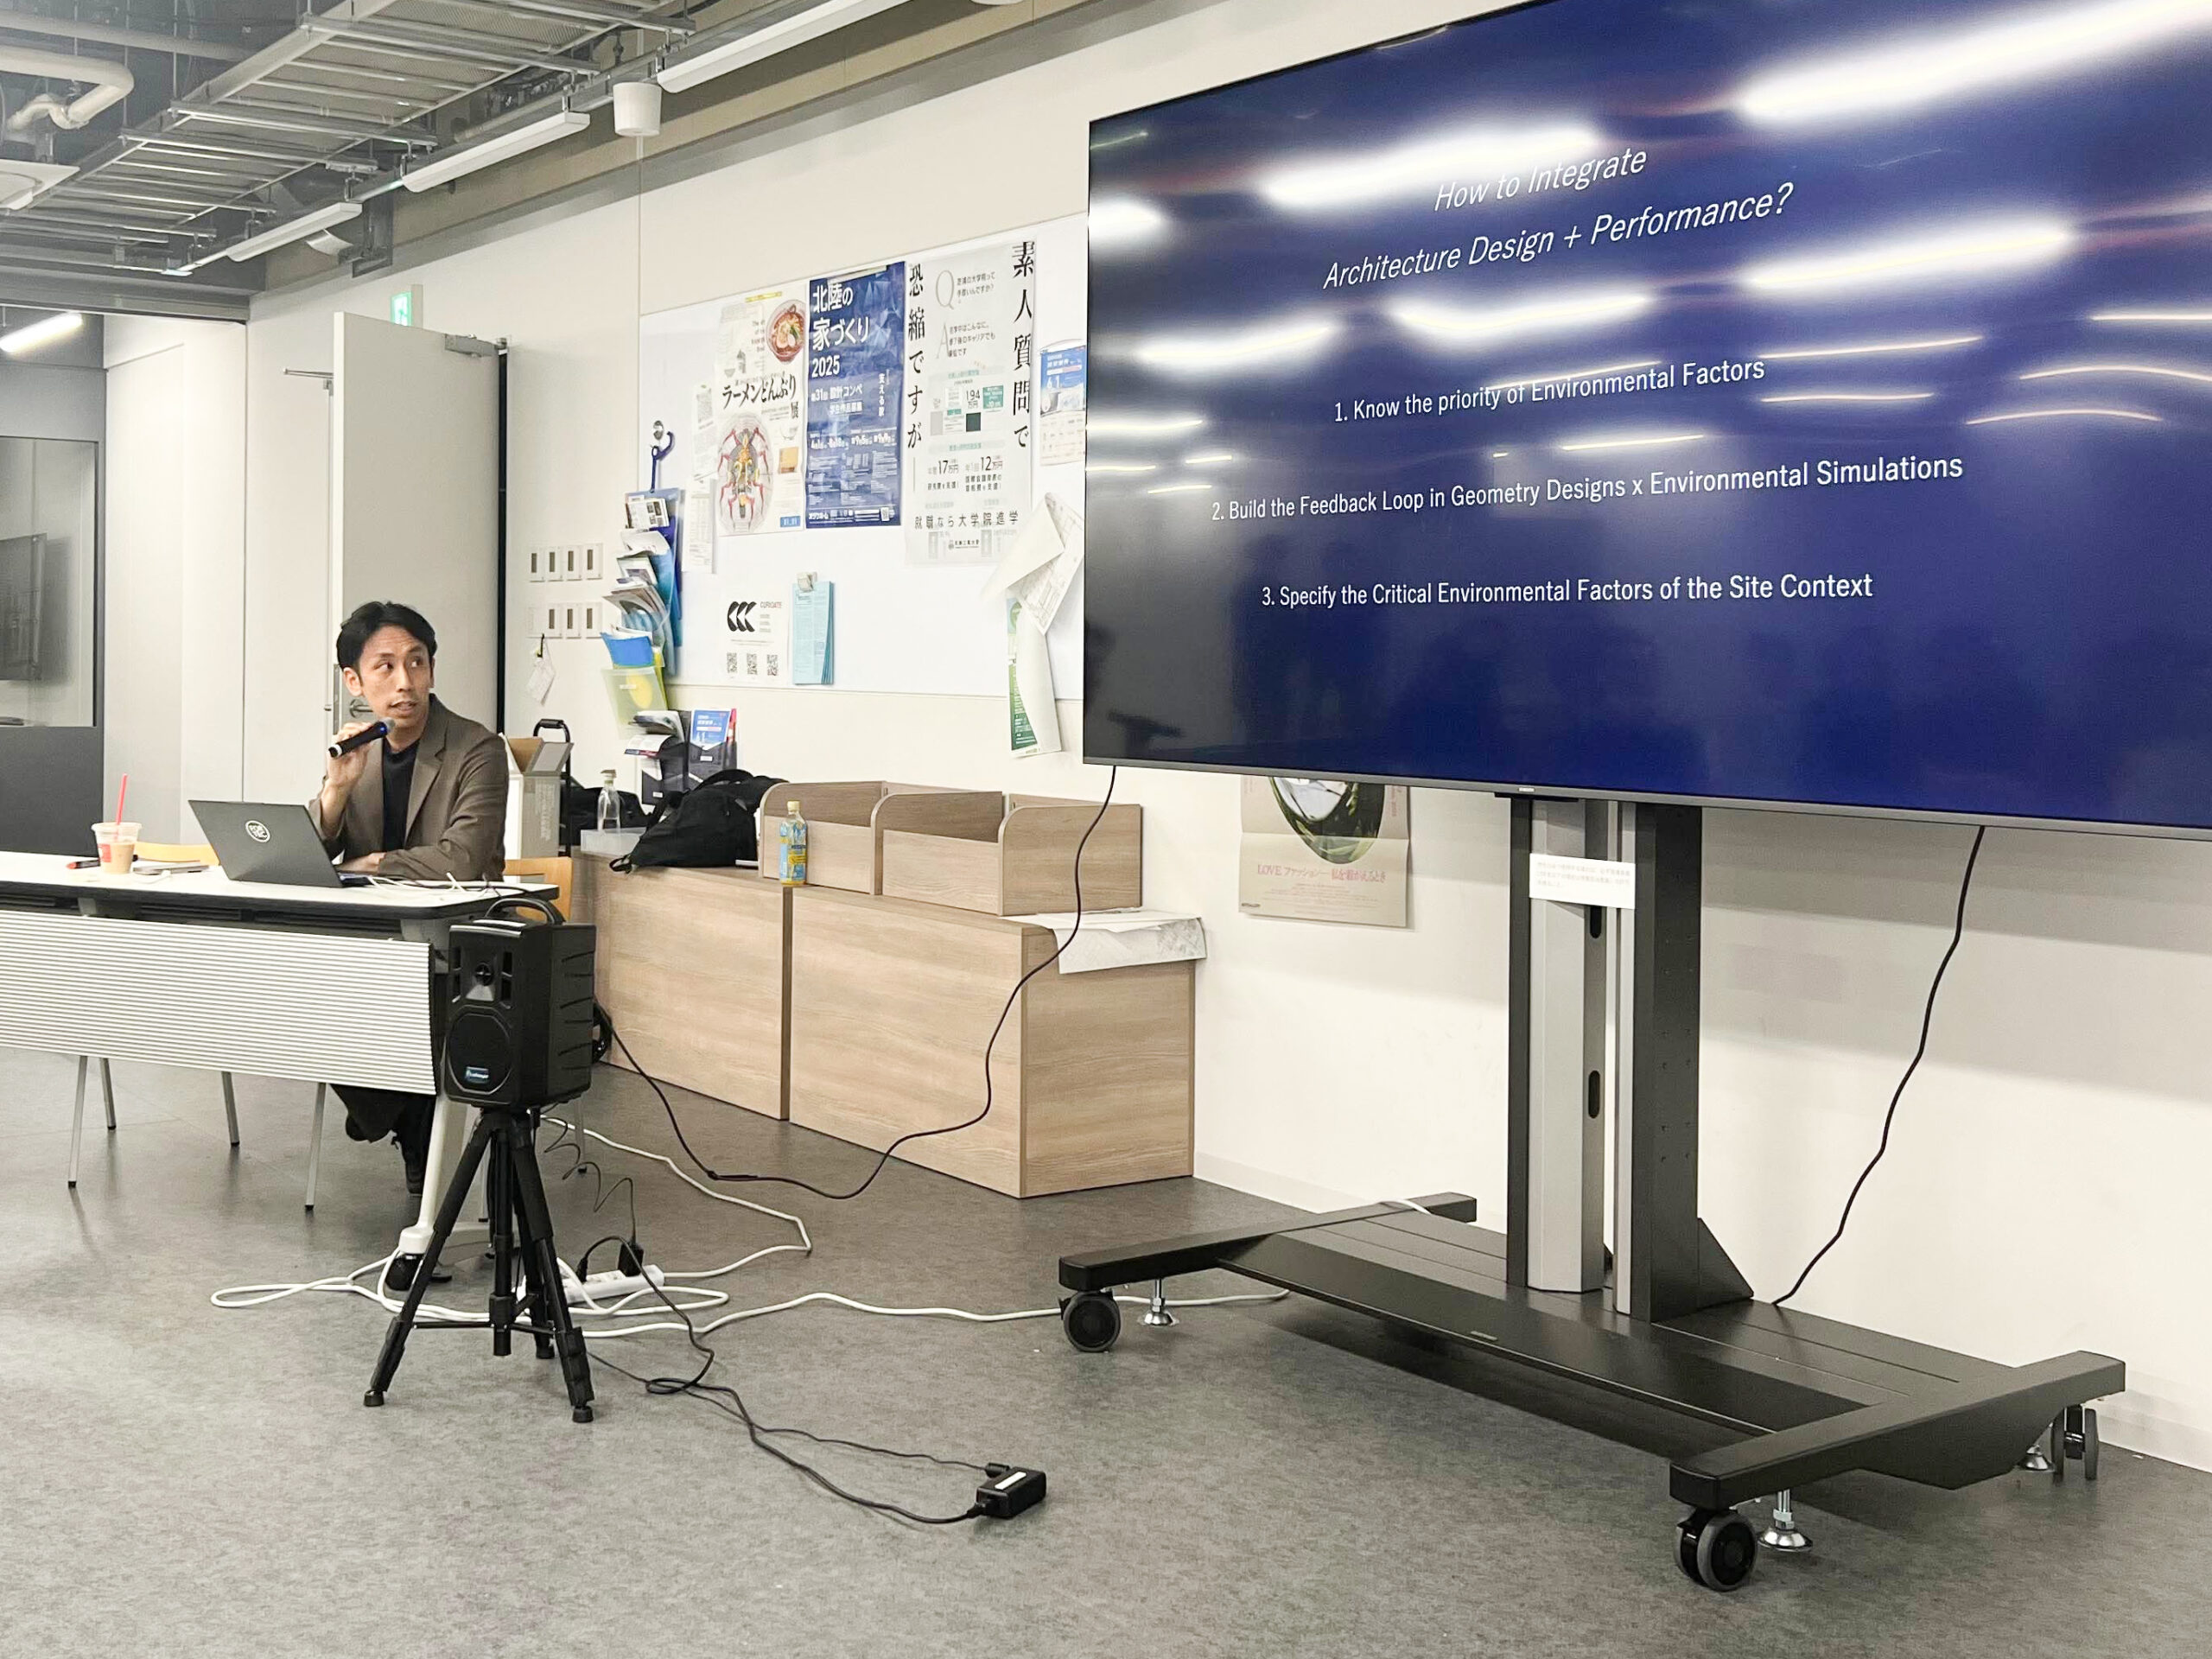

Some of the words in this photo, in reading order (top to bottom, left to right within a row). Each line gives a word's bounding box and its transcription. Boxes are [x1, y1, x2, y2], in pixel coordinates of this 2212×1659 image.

[1434, 181, 1490, 211] How
[1497, 175, 1520, 200] to
[1529, 148, 1646, 191] Integrate
[1323, 248, 1461, 289] Architecture
[1468, 230, 1554, 265] Design
[1591, 181, 1794, 245] Performance?
[812, 283, 854, 313] 北陸の
[936, 270, 954, 310] Q
[812, 316, 870, 351] 家づくり
[1012, 241, 1035, 448] 素人質問で
[811, 355, 840, 378] 2025
[907, 264, 925, 448] 恐縮ですが
[722, 373, 797, 410] ラーメンどんぶり
[966, 390, 981, 401] 194
[1335, 402, 1348, 422] 1.
[1354, 399, 1400, 420] Know
[1405, 394, 1433, 415] the
[1439, 387, 1501, 416] priority
[1507, 383, 1525, 404] of
[1532, 365, 1674, 402] Environmental
[1683, 359, 1764, 386] Factors
[1211, 502, 1224, 520] 2.
[1230, 499, 1266, 519] Build
[1271, 498, 1294, 517] the
[1300, 492, 1376, 515] Feedback
[1382, 491, 1423, 512] Loop
[1430, 488, 1445, 507] in
[1452, 482, 1540, 506] Geometry
[1547, 478, 1625, 502] Designs
[1631, 479, 1643, 495] x
[1650, 461, 1808, 495] Environmental
[1816, 455, 1963, 485] Simulations
[1262, 587, 1275, 606] 3.
[1280, 585, 1336, 608] Specify
[1341, 584, 1367, 604] the
[1373, 582, 1432, 603] Critical
[1438, 579, 1570, 603] Environmental
[1577, 578, 1653, 601] Factors
[1660, 576, 1681, 600] of
[1687, 575, 1722, 600] the
[1729, 575, 1772, 598] Site
[1780, 574, 1873, 598] Context
